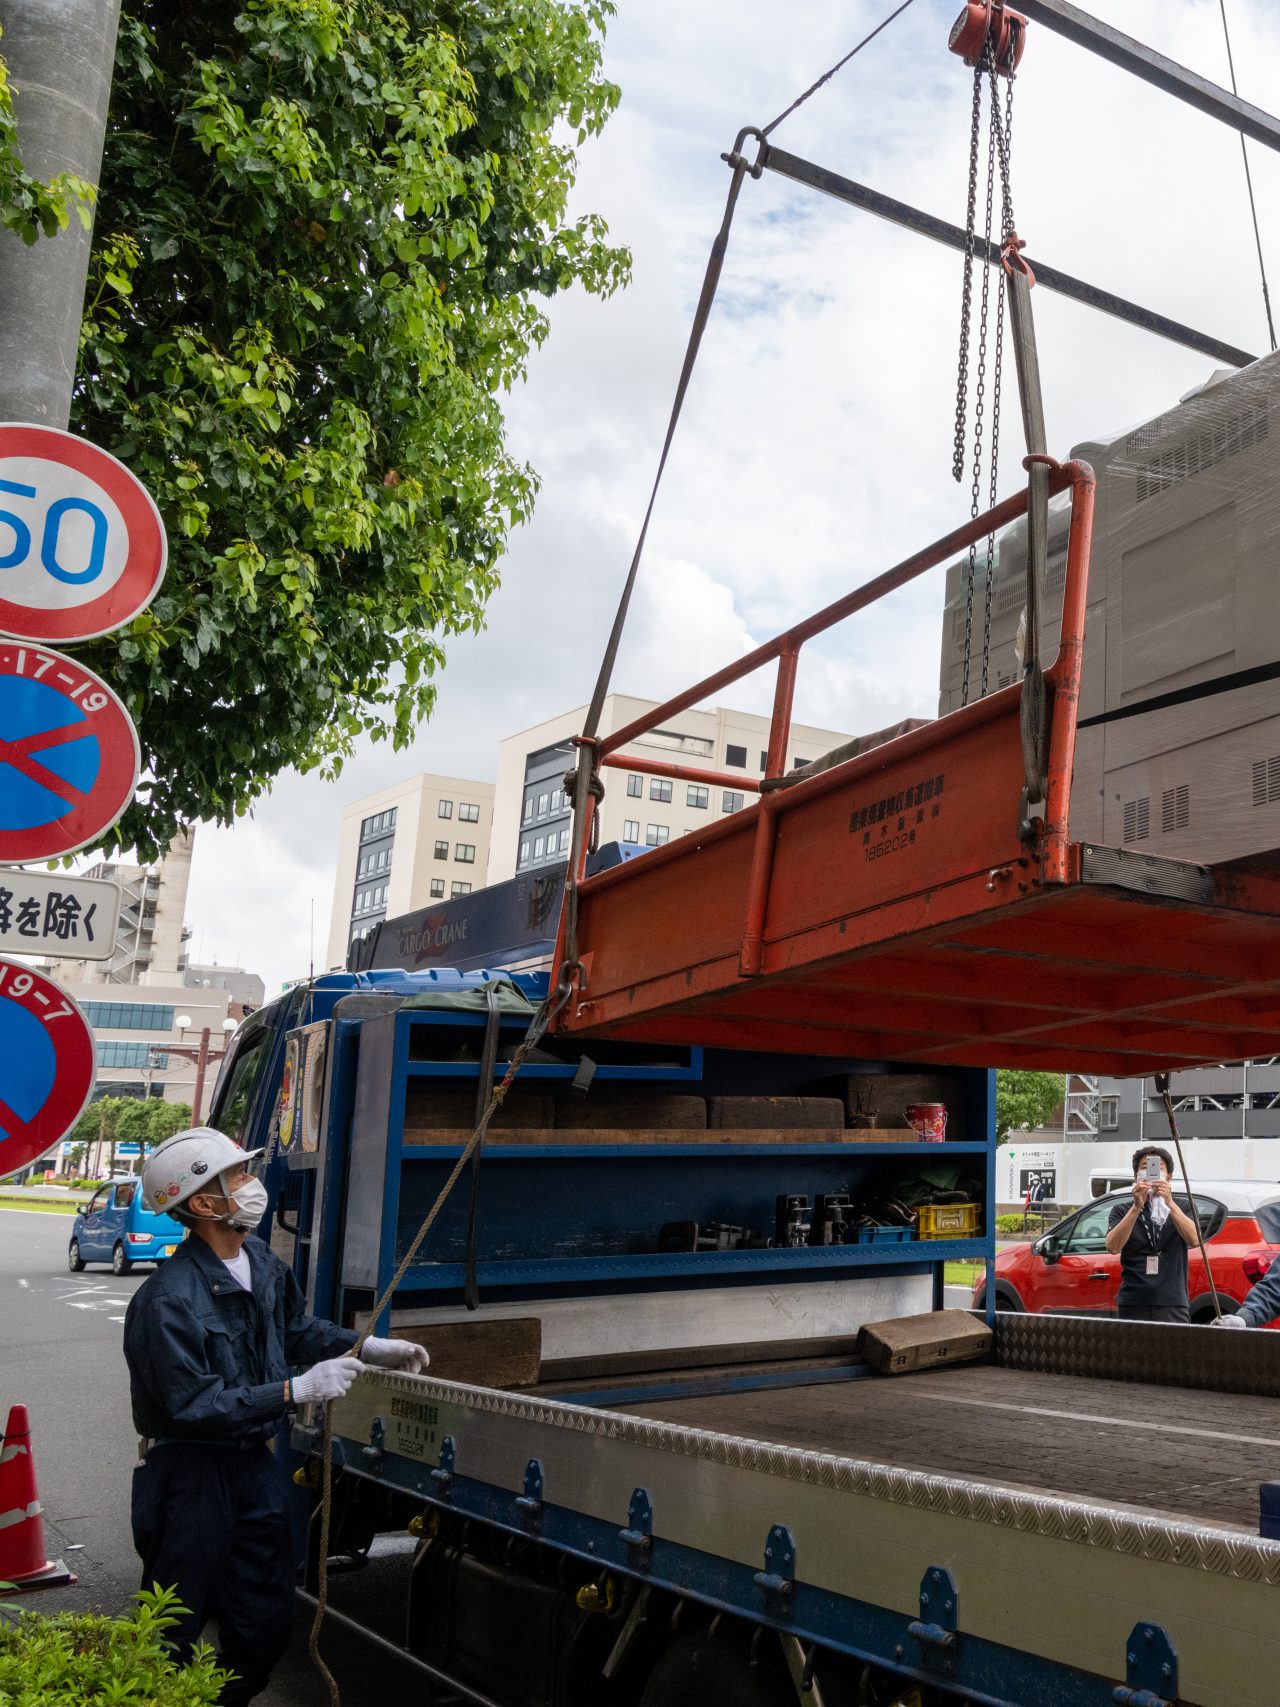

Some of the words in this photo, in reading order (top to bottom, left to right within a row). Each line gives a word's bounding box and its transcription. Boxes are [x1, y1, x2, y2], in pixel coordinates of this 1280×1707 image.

[0, 479, 108, 585] 50
[398, 929, 431, 957] CARGO
[435, 918, 469, 947] CRANE
